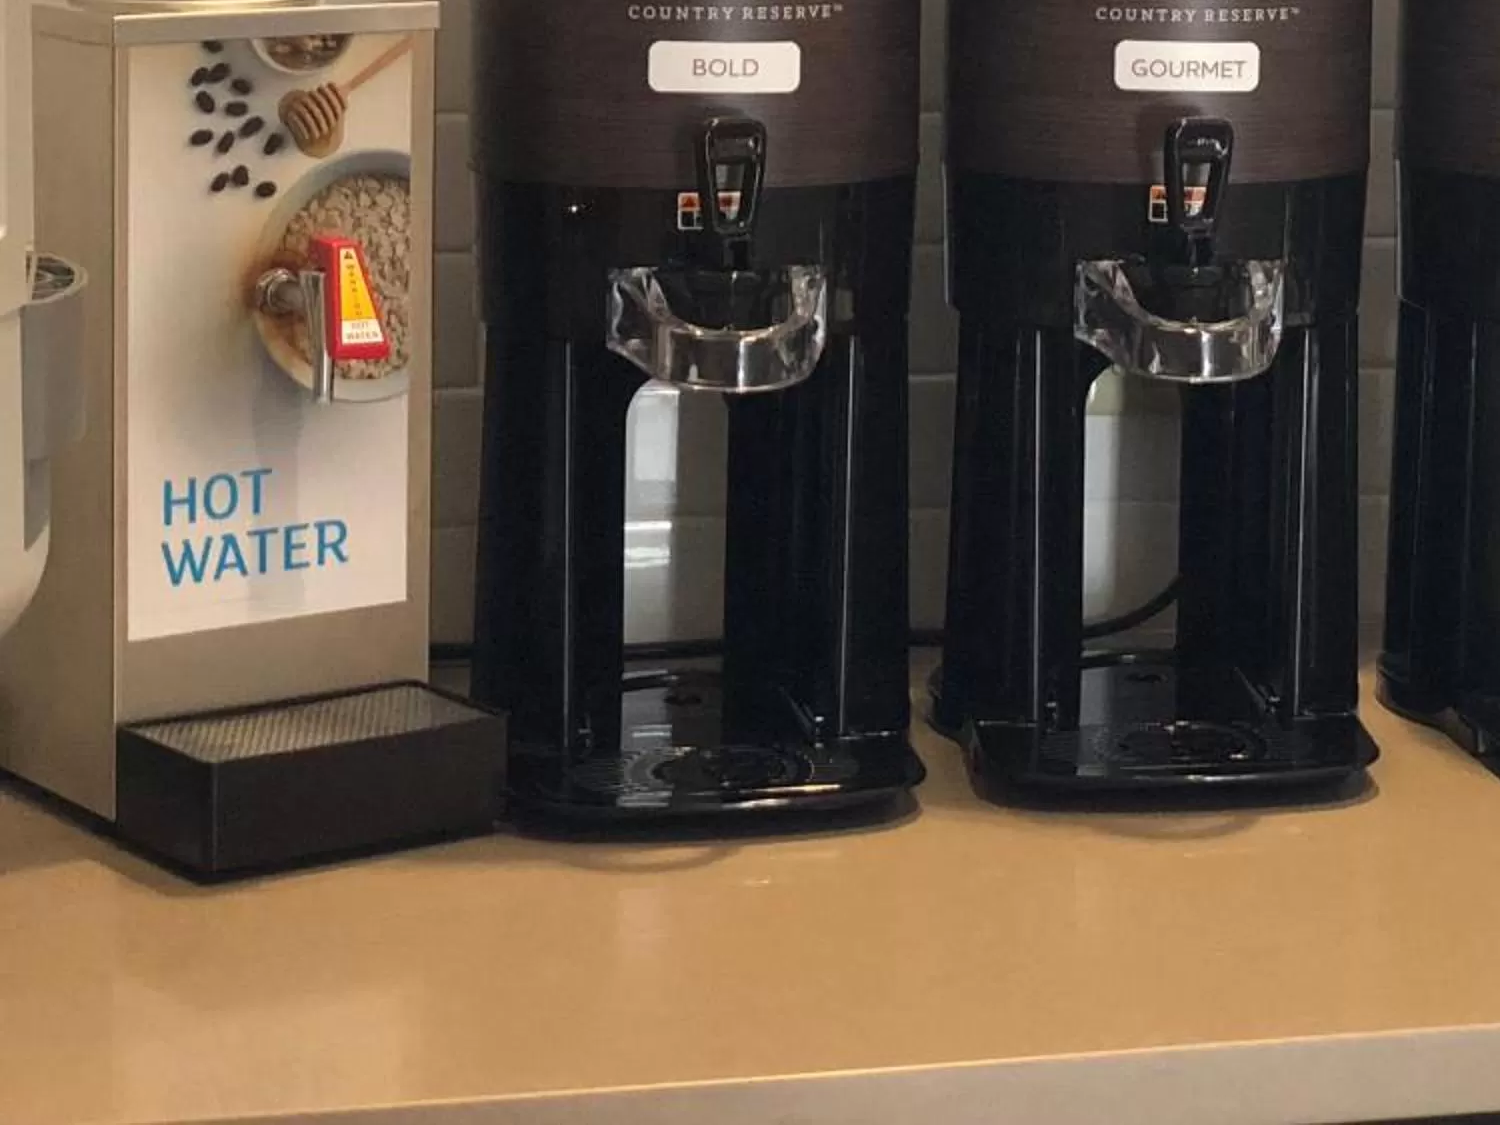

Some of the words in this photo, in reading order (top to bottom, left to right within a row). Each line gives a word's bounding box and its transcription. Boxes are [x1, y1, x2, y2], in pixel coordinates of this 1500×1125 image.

[627, 4, 734, 20] COUNTRY
[1095, 7, 1198, 22] COUNTRY
[692, 58, 760, 77] BOLD
[1131, 58, 1247, 78] GOURMET
[162, 468, 273, 527] HOT
[161, 518, 349, 588] WATER
